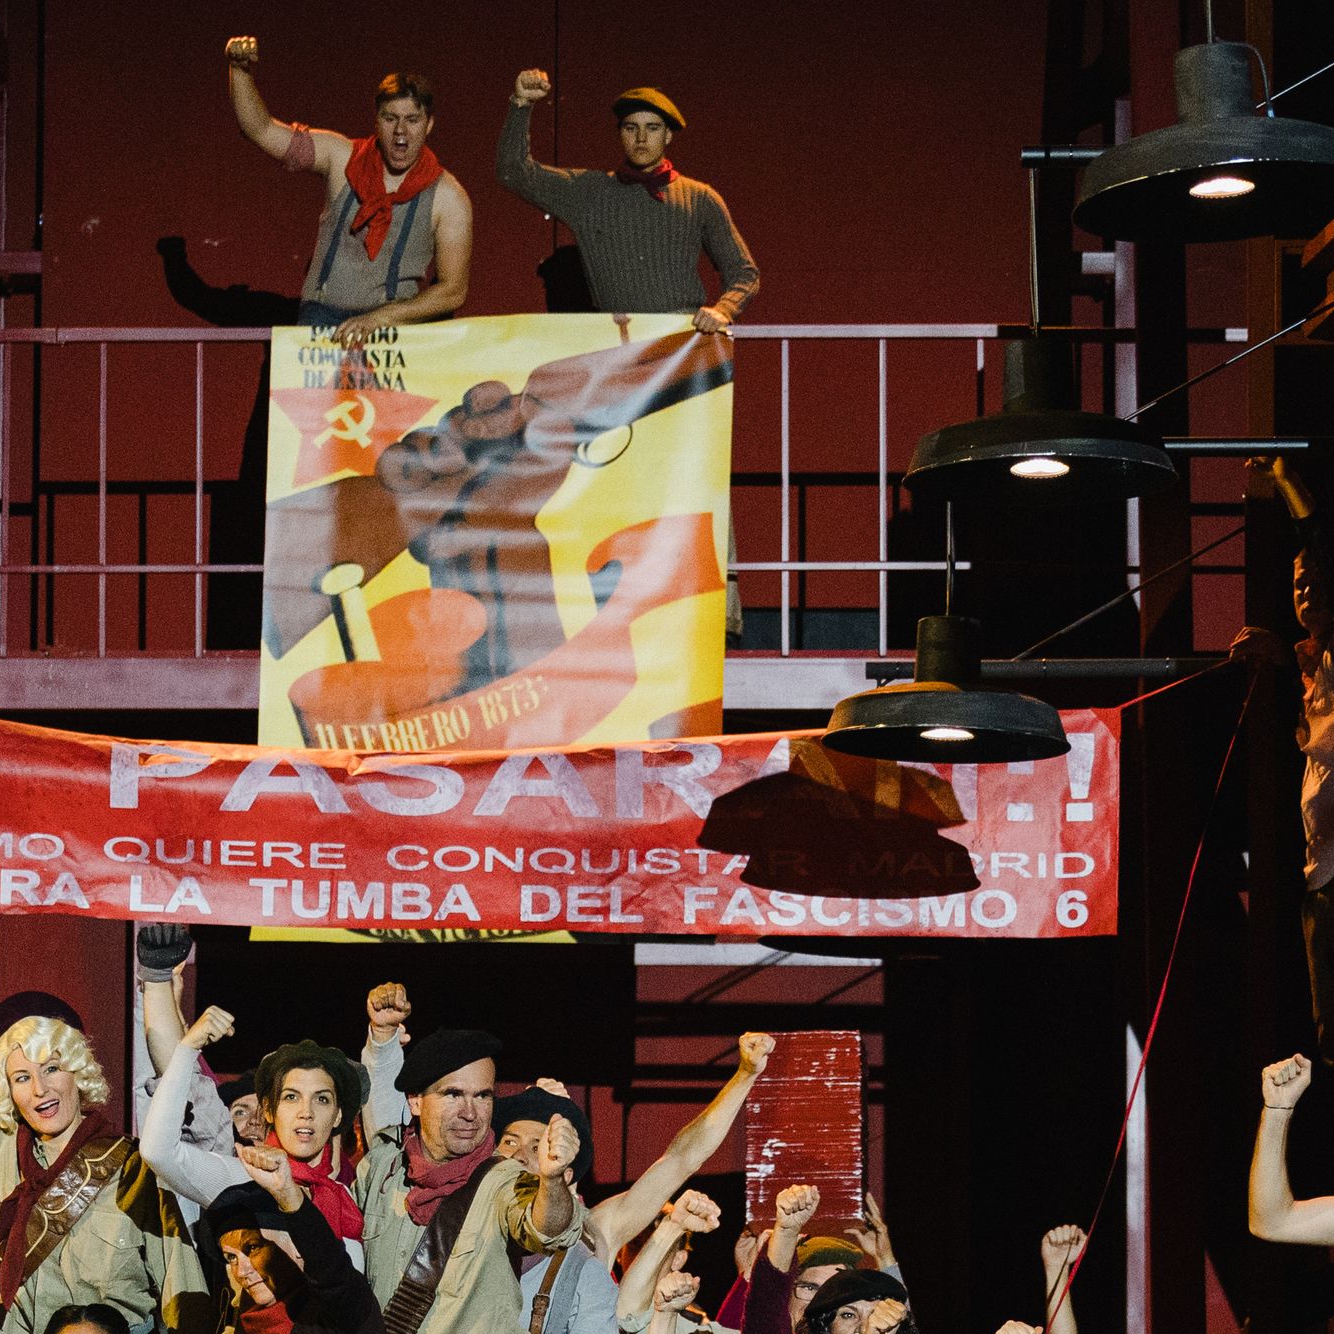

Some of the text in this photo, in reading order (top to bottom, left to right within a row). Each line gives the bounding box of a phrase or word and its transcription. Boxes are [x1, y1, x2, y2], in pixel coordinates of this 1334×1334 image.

[342, 704, 471, 752] FEBRERO
[103, 836, 347, 870] QUIERE
[129, 874, 213, 916] LA
[248, 877, 482, 922] TUMBA
[519, 884, 644, 924] DEL
[682, 885, 1018, 929] FASCISMO
[1055, 889, 1090, 929] 6
